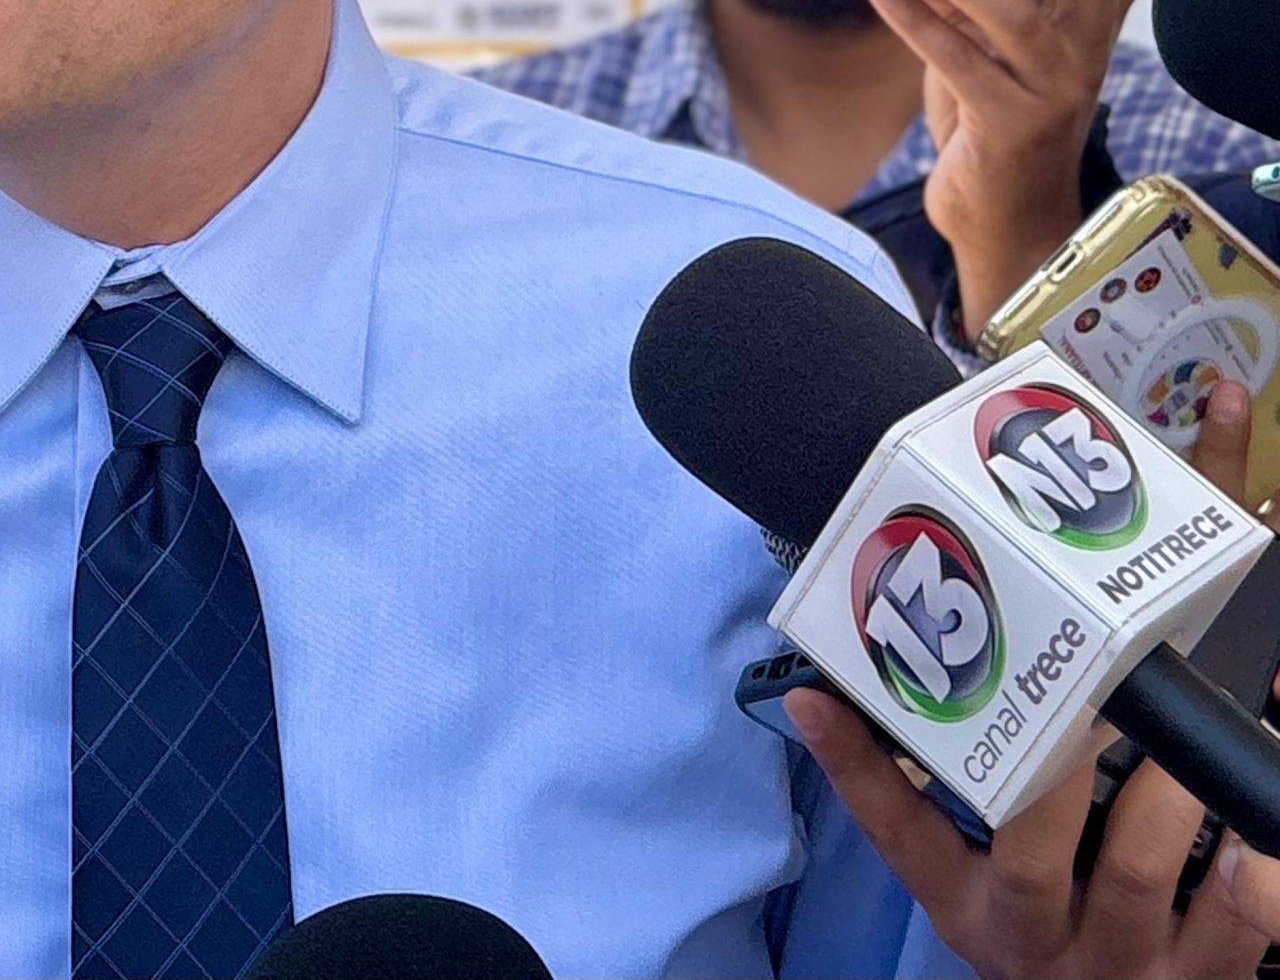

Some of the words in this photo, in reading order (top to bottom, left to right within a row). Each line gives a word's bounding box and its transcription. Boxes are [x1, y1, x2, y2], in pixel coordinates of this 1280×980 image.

[865, 530, 989, 704] 13
[1097, 505, 1232, 604] NOTITRECE
[963, 689, 1028, 784] canal
[1015, 617, 1086, 706] trece
